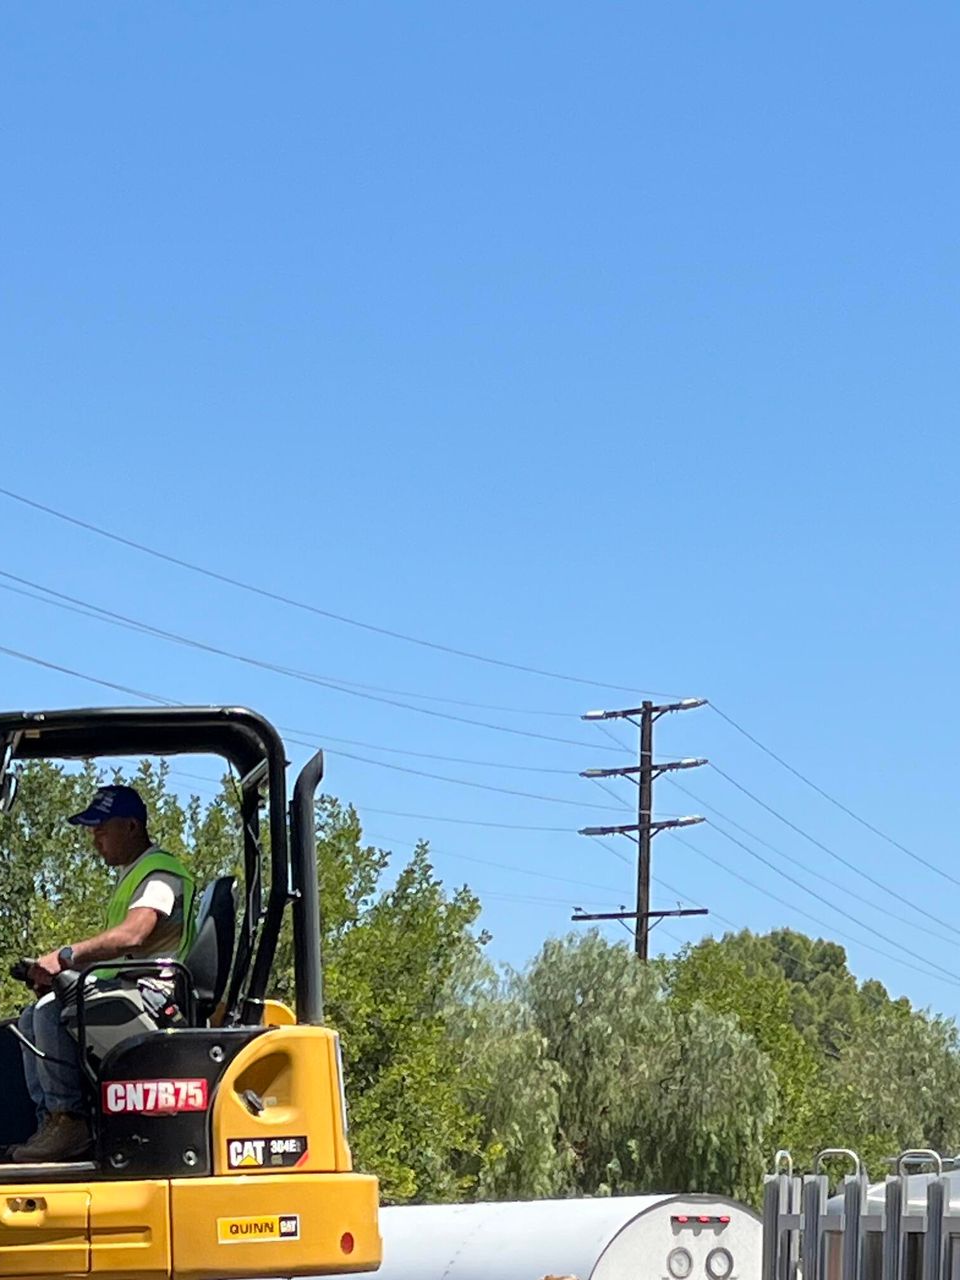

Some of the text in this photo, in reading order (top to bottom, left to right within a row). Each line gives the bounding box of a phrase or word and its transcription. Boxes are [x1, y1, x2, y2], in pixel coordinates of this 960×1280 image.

[106, 1081, 204, 1112] CN7B75
[230, 1140, 266, 1167] CAT
[229, 1222, 275, 1235] QUINN
